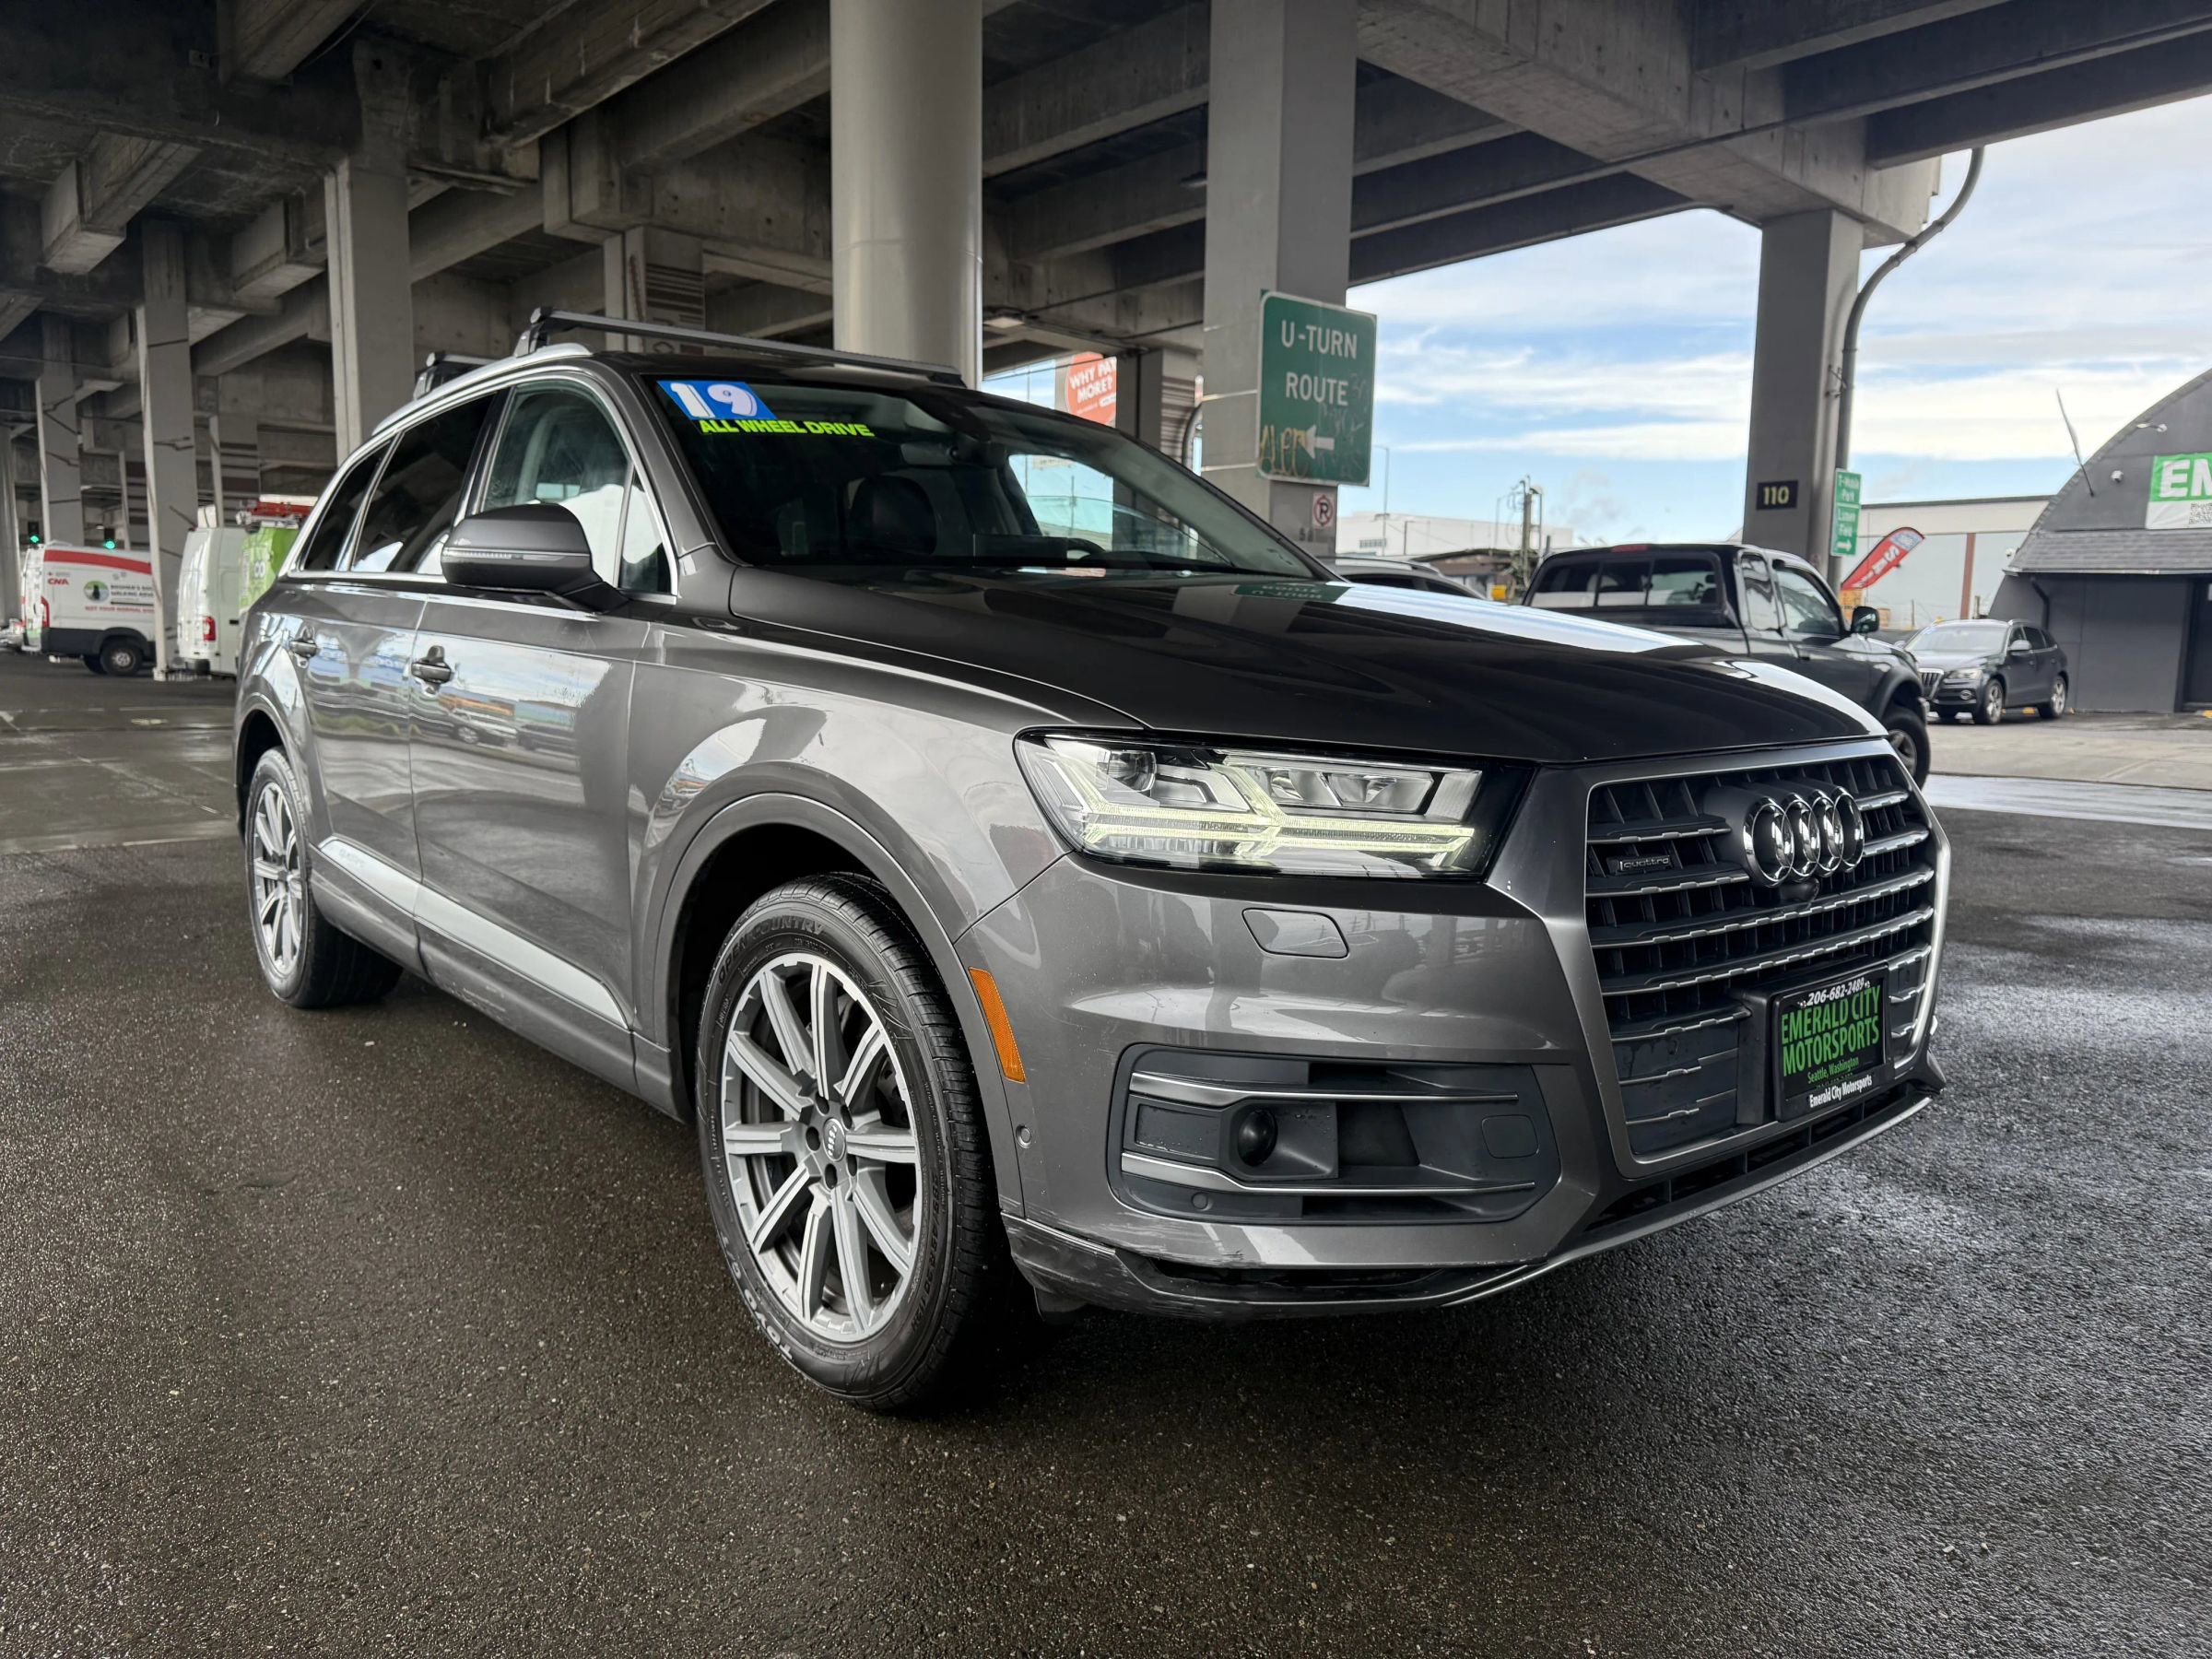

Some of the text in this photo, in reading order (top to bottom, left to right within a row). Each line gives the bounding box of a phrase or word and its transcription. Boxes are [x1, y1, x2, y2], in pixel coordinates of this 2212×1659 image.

[1281, 319, 1358, 359] U-TURN
[1069, 365, 1096, 390] WHY
[1077, 375, 1113, 404] MORE?
[1286, 371, 1348, 406] ROUTE
[670, 382, 758, 419] 19
[700, 419, 875, 437] ALL WHEEL DRIVE
[1763, 486, 1790, 505] 110
[1782, 984, 1880, 1044] EMERALD CITY
[1783, 1015, 1880, 1077] MOTORSPORTS
[1829, 1056, 1860, 1076] Washington
[1808, 1088, 1831, 1108] Emerald
[1831, 1084, 1842, 1101] City
[1841, 1074, 1873, 1094] Motorsports
[744, 1288, 793, 1359] TOYO
